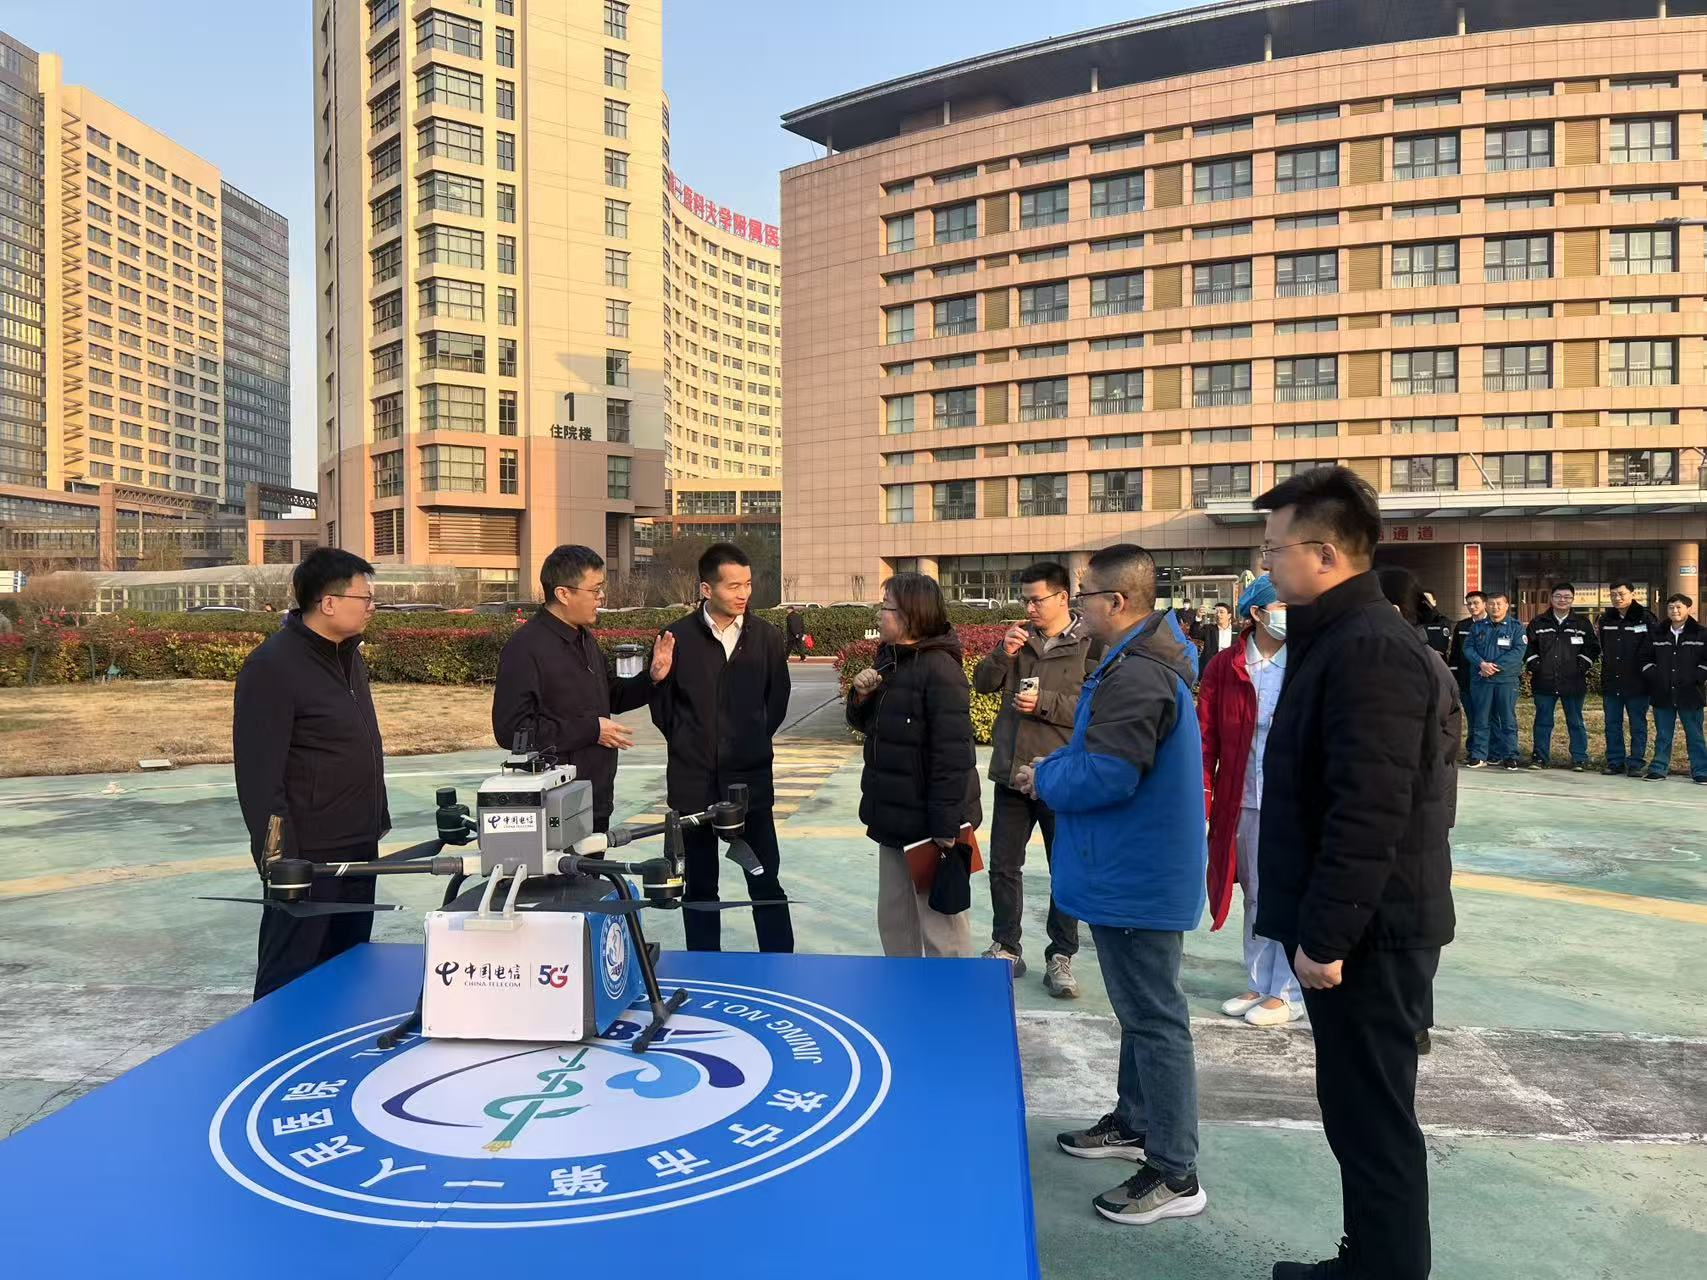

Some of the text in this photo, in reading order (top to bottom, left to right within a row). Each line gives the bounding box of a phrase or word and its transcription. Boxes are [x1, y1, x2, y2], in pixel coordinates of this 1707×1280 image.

[564, 392, 575, 422] 1
[550, 424, 592, 441] 住院楼
[503, 815, 534, 825] 中国电信
[464, 962, 521, 981] 中国电信
[537, 964, 569, 989] 5G
[701, 1000, 769, 1022] NO.1
[766, 1019, 823, 1065] JINING
[272, 1079, 831, 1196] 济宁市第一人民医院
